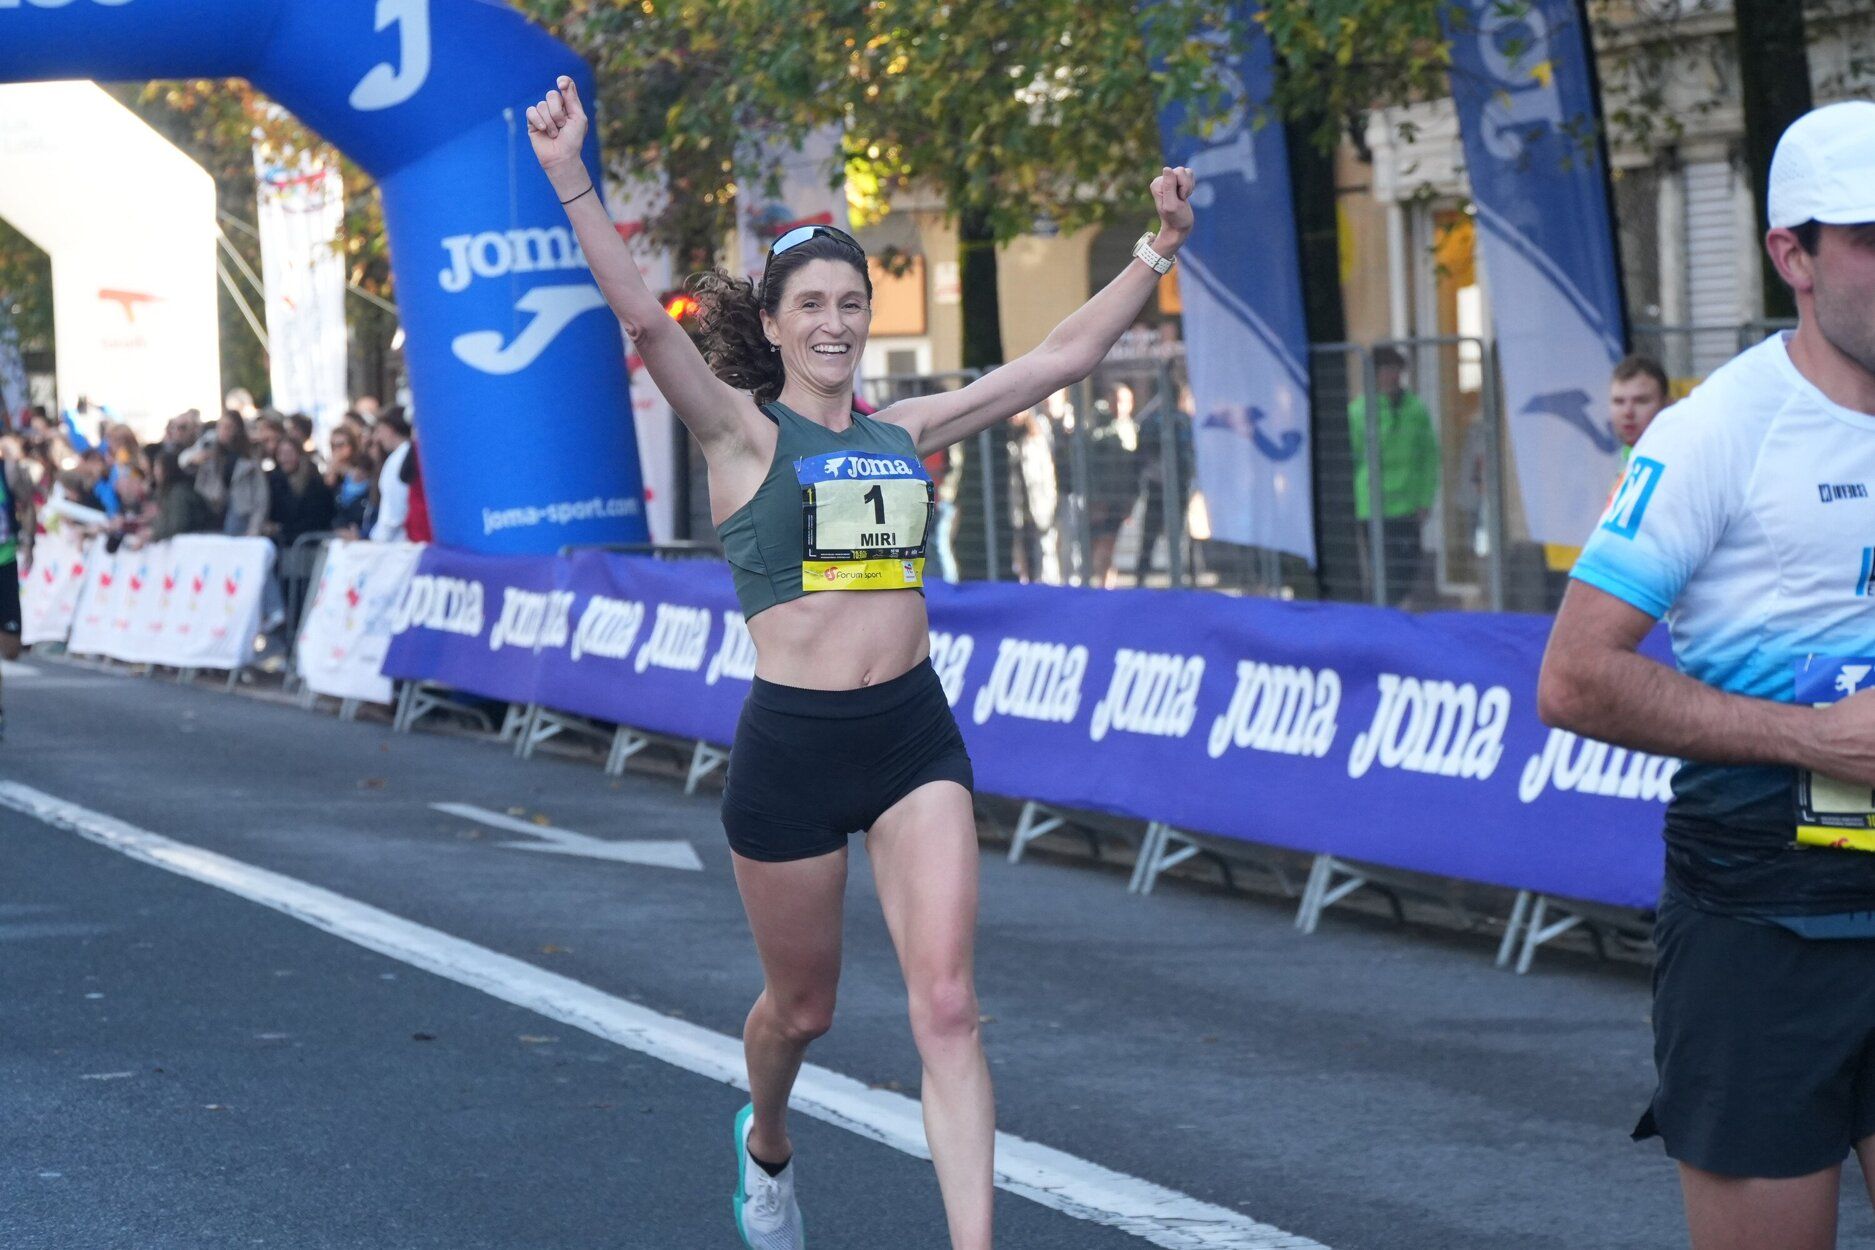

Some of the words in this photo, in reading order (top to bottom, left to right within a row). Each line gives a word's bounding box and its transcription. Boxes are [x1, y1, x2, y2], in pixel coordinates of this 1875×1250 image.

[847, 456, 913, 477] Joma
[482, 497, 638, 537] joma-sport.com
[864, 485, 886, 525] 1
[860, 532, 896, 547] MIRI
